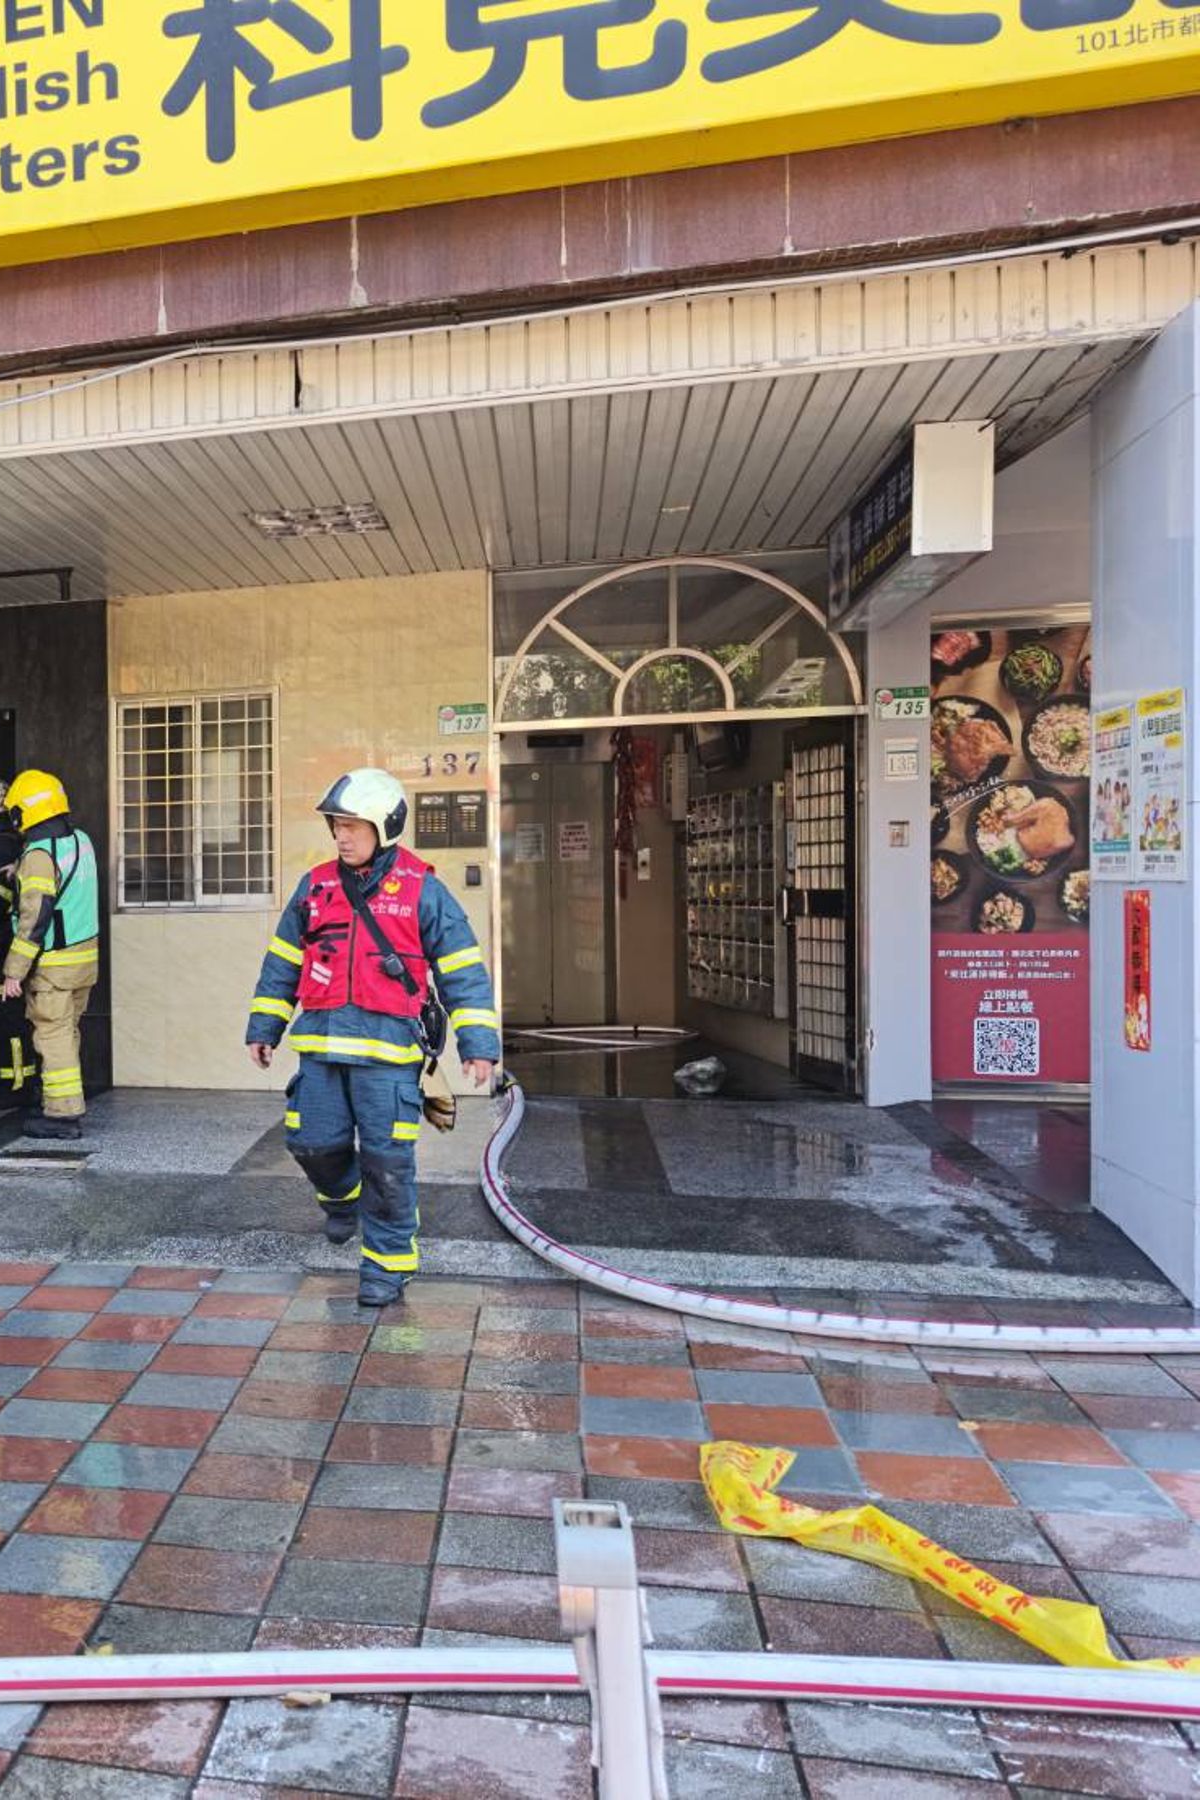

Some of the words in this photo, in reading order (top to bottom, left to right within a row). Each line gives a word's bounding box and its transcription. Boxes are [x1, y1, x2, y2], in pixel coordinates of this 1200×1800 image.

[894, 700, 925, 716] 135
[457, 717, 481, 730] 137
[421, 752, 481, 777] 137
